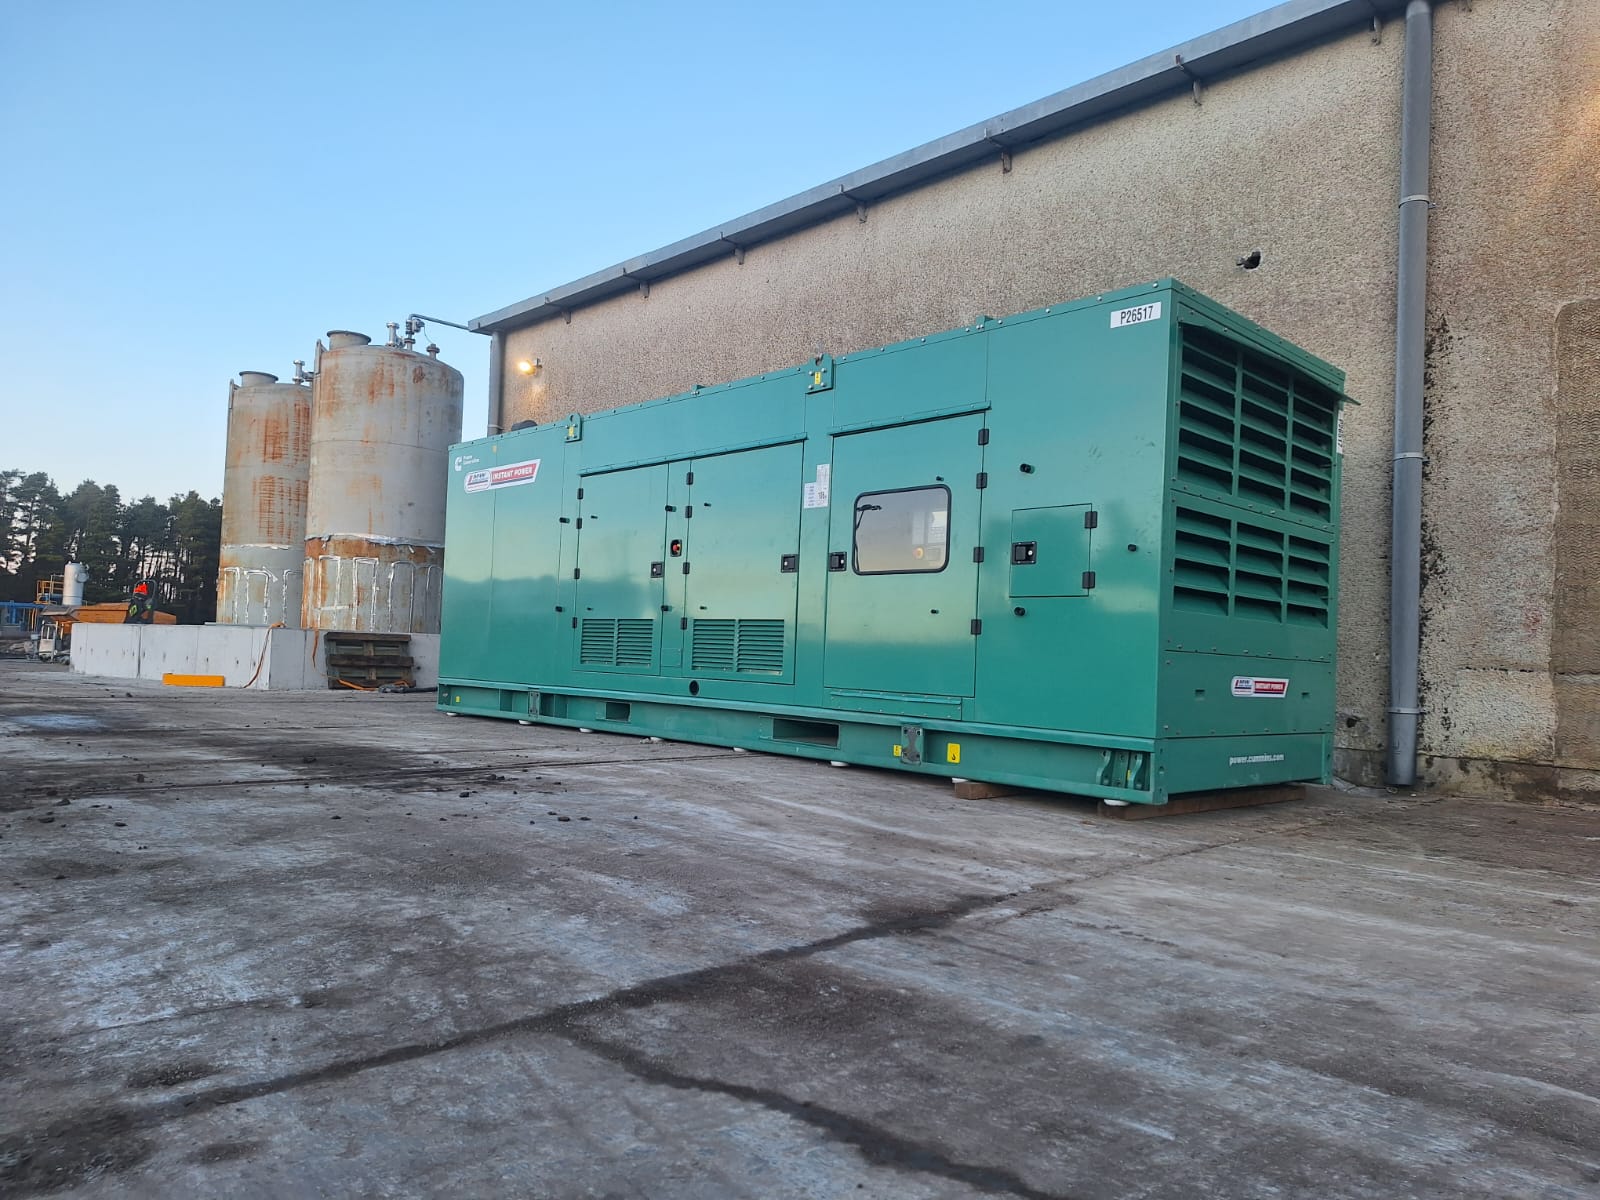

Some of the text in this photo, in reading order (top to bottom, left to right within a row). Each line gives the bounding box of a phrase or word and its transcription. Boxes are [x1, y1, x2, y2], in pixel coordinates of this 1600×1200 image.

[1120, 305, 1154, 325] P26517
[493, 470, 514, 480] INSTANT
[514, 467, 533, 476] POWER
[1229, 752, 1285, 766] power.cummins.com
